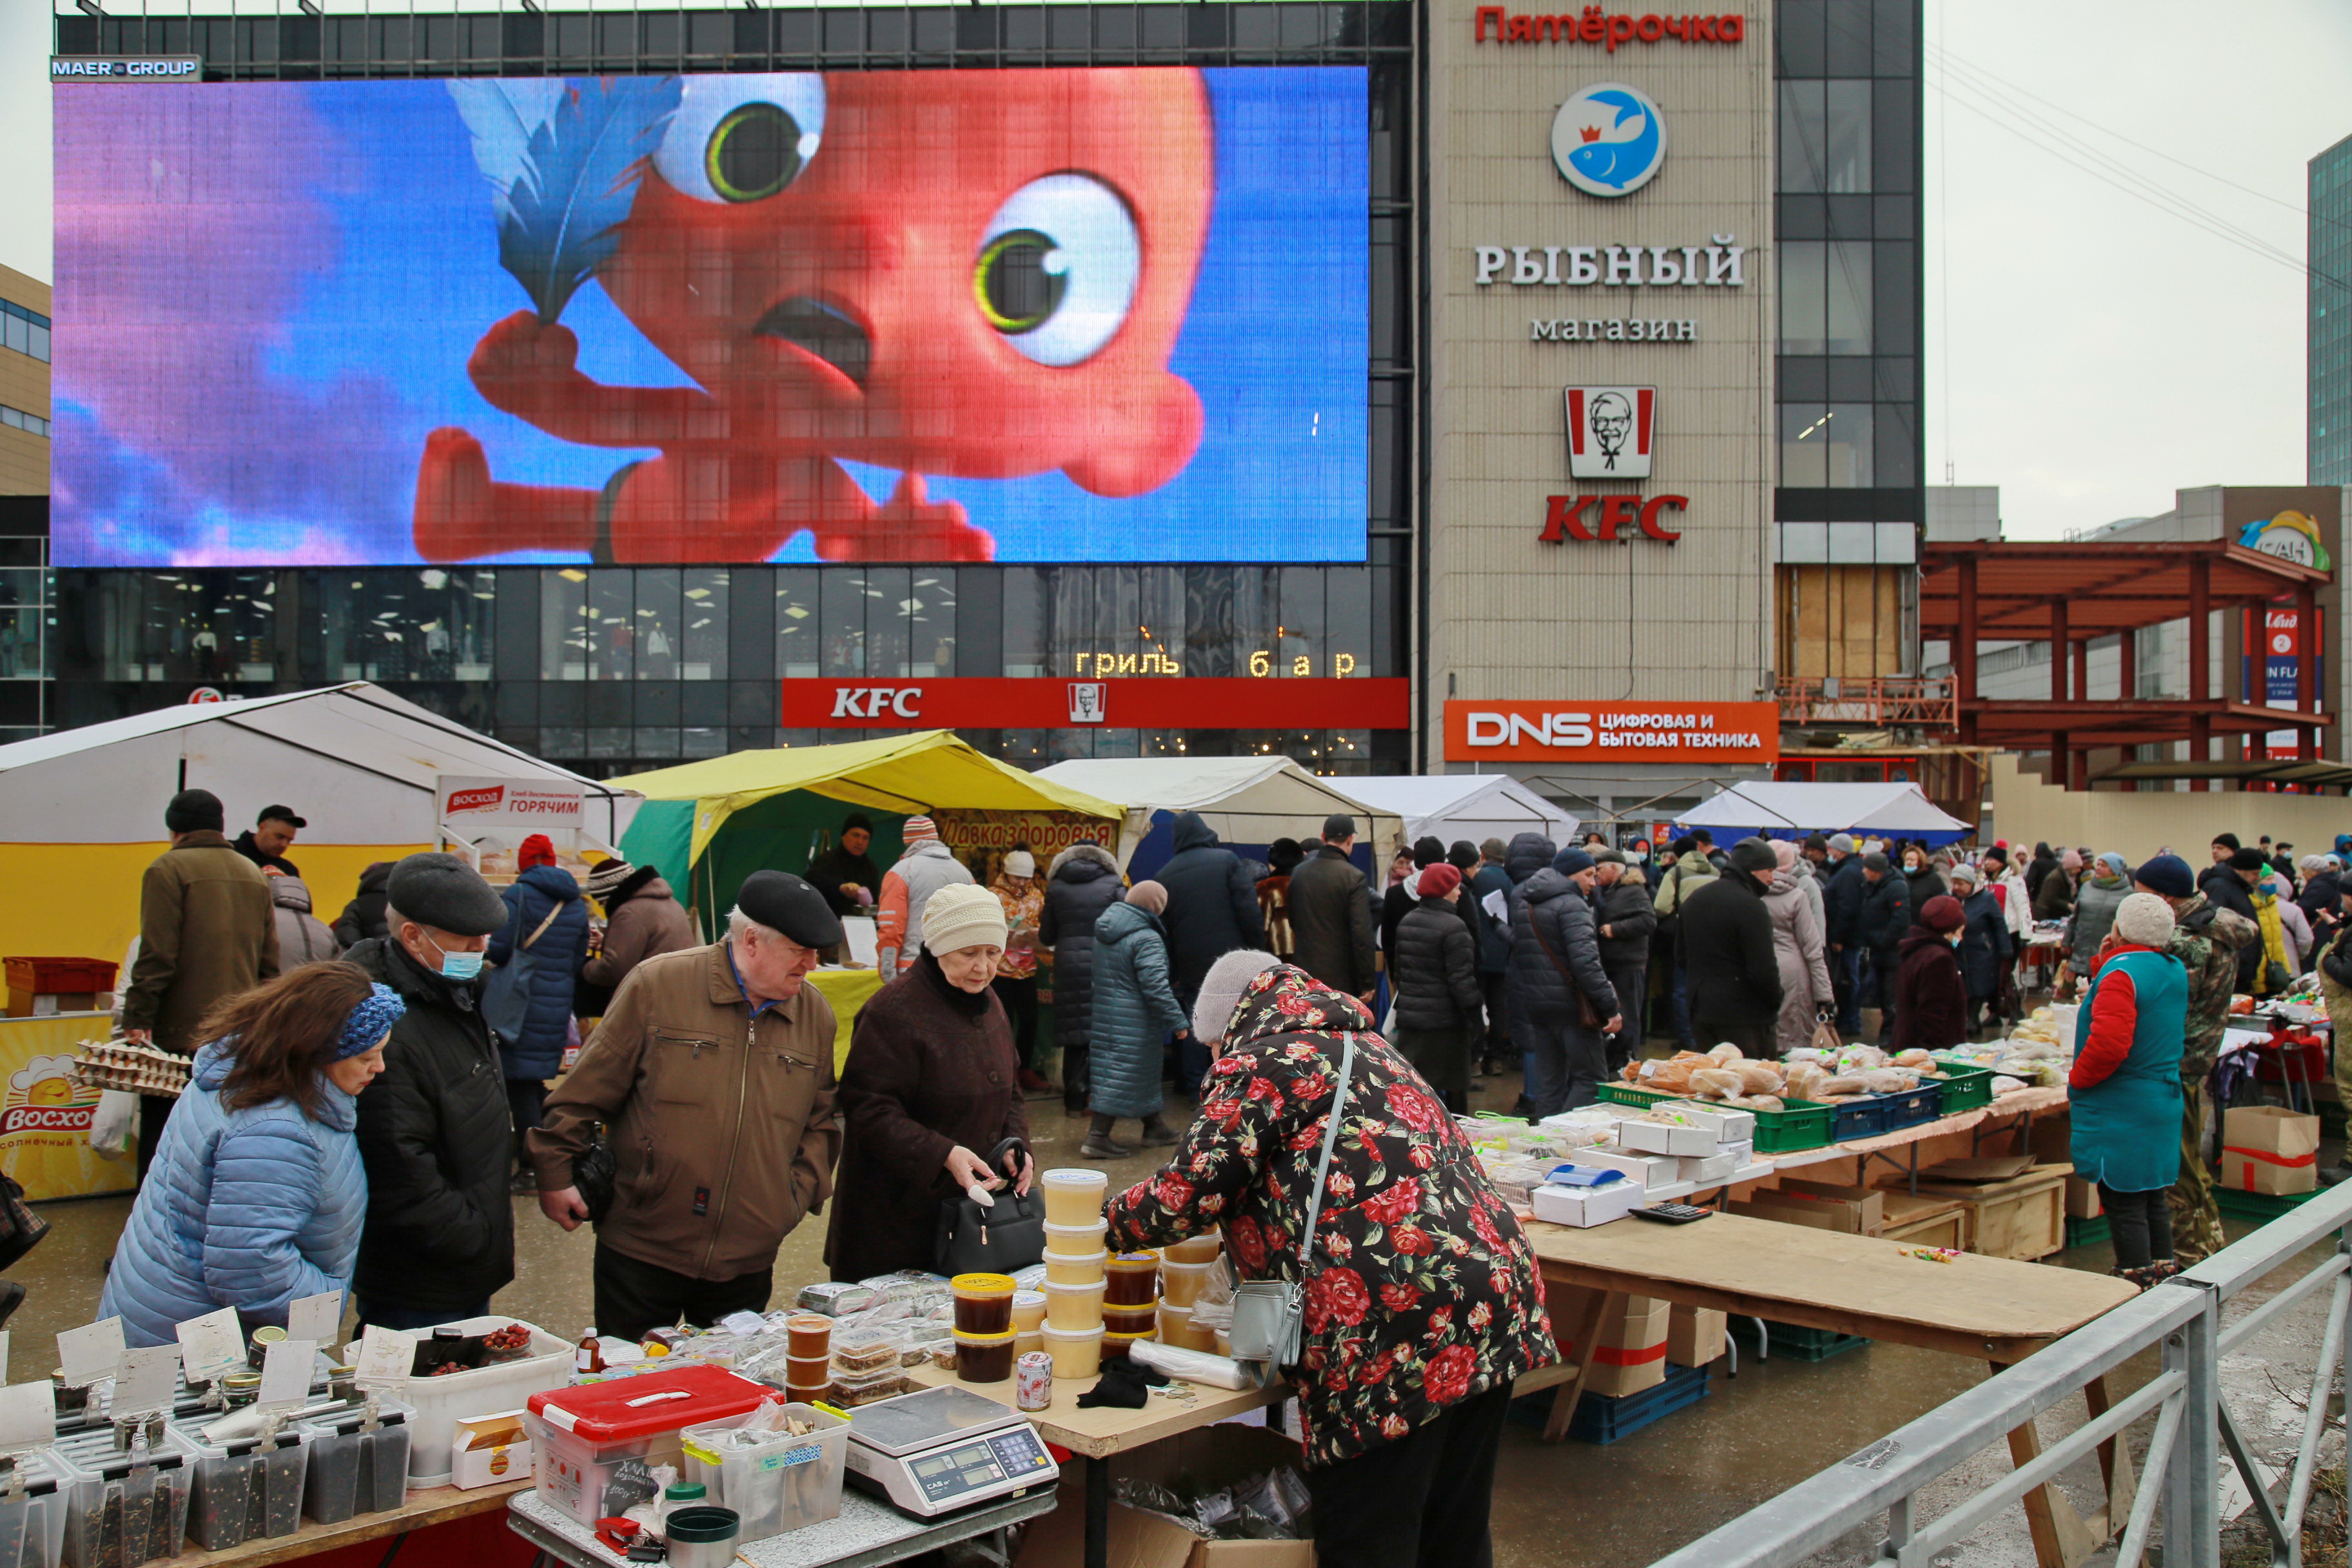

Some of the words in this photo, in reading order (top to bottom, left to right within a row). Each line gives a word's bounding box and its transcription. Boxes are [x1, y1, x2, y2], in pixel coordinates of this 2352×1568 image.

[1475, 5, 1745, 52] Пятёрочка
[52, 61, 113, 75] MAER
[126, 61, 197, 75] GROUP
[1475, 233, 1745, 286] РЫБНЫЙ
[1531, 318, 1698, 342] магазин
[1538, 495, 1689, 542] KFC
[1076, 652, 1180, 680] гриль
[830, 687, 923, 718] KFC
[1467, 712, 1594, 747] DNS
[1599, 713, 1695, 730] ЦИФРОВАЯ
[1702, 714, 1714, 729] И
[1599, 732, 1679, 747] БЫТОВАЯ
[1683, 732, 1761, 749] ТЕХНИКА
[453, 792, 498, 806] ВОСХОД
[509, 800, 579, 814] ГОРЯЧИМ
[942, 818, 1003, 846] Лавка
[1006, 818, 1111, 854] здоровья
[6, 1109, 98, 1130] Восхо
[0, 1138, 74, 1150] солнечный
[926, 1480, 943, 1490] CAS
